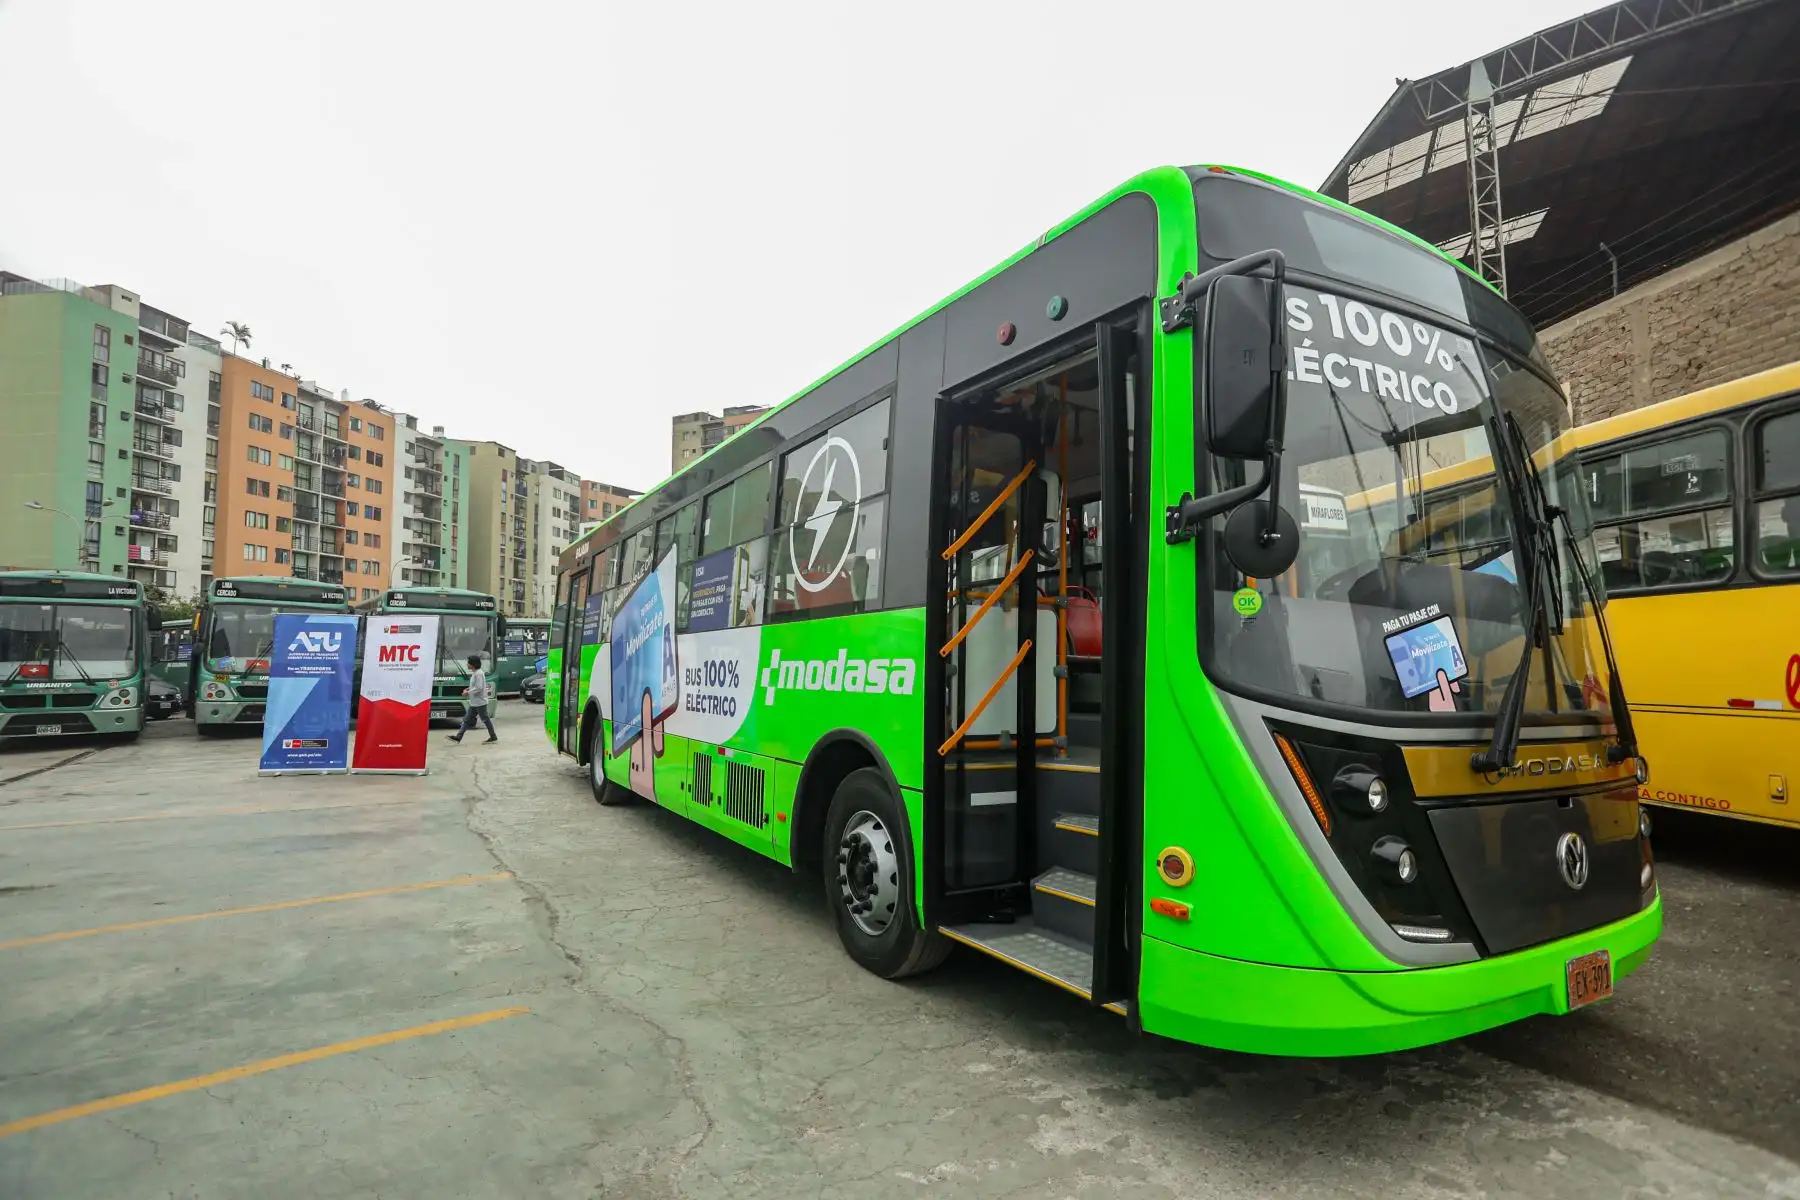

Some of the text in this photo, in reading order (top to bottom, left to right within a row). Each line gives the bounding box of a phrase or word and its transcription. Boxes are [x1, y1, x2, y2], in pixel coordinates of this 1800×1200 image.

[1318, 294, 1454, 372] 100%
[1287, 338, 1458, 415] ÉCTRICO
[1311, 506, 1344, 520] MIRAFLORES
[217, 589, 237, 597] CERCADO
[1239, 597, 1256, 606] OK
[1382, 603, 1440, 633] PAGA TU PASJE CON
[288, 631, 341, 652] ATU
[379, 645, 420, 662] MTC
[1411, 640, 1448, 658] Movilízate
[685, 659, 740, 688] BUS 100%
[777, 649, 916, 695] modasa
[686, 689, 737, 718] ELÉCTRICO
[1505, 752, 1604, 777] MODASA
[1656, 790, 1731, 810] CONTIGO
[1575, 963, 1610, 1000] EX-391
